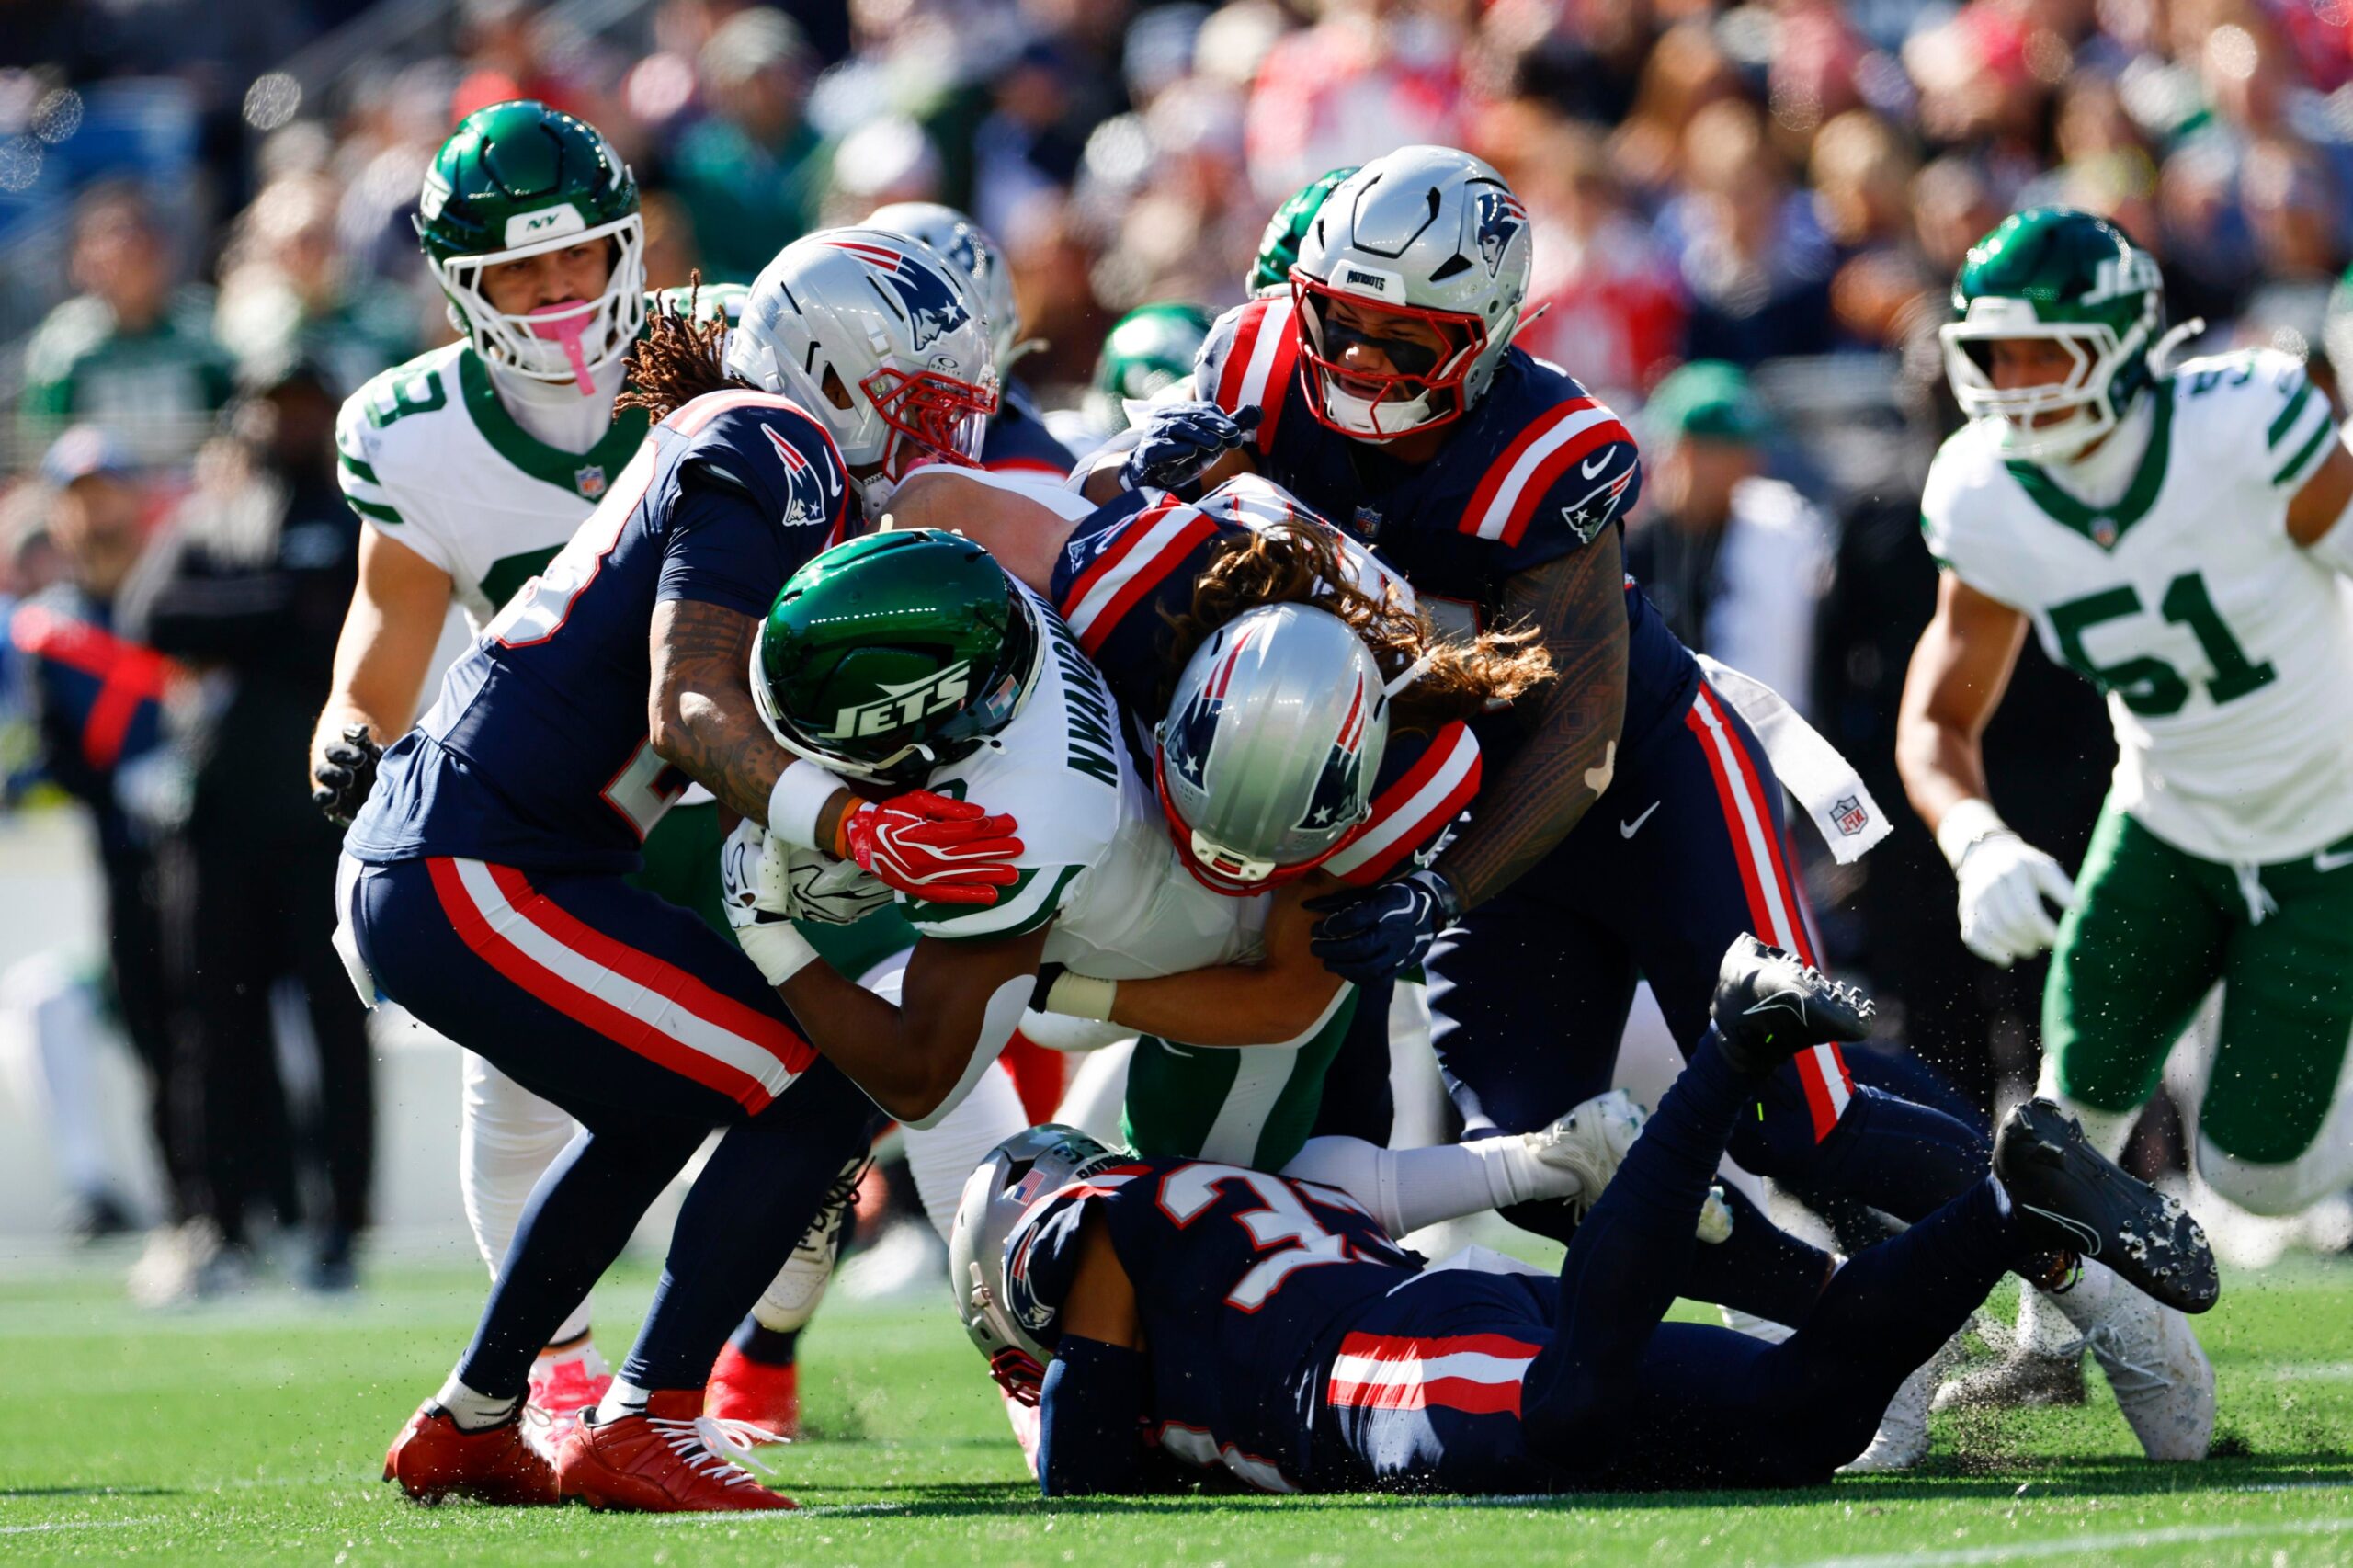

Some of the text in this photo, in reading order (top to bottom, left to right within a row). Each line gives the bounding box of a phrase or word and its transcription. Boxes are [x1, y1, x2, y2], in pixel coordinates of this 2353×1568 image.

[525, 212, 561, 233] NY
[1347, 269, 1386, 292] PATRIOTS
[2045, 569, 2279, 719] 51
[816, 659, 971, 740] JETS
